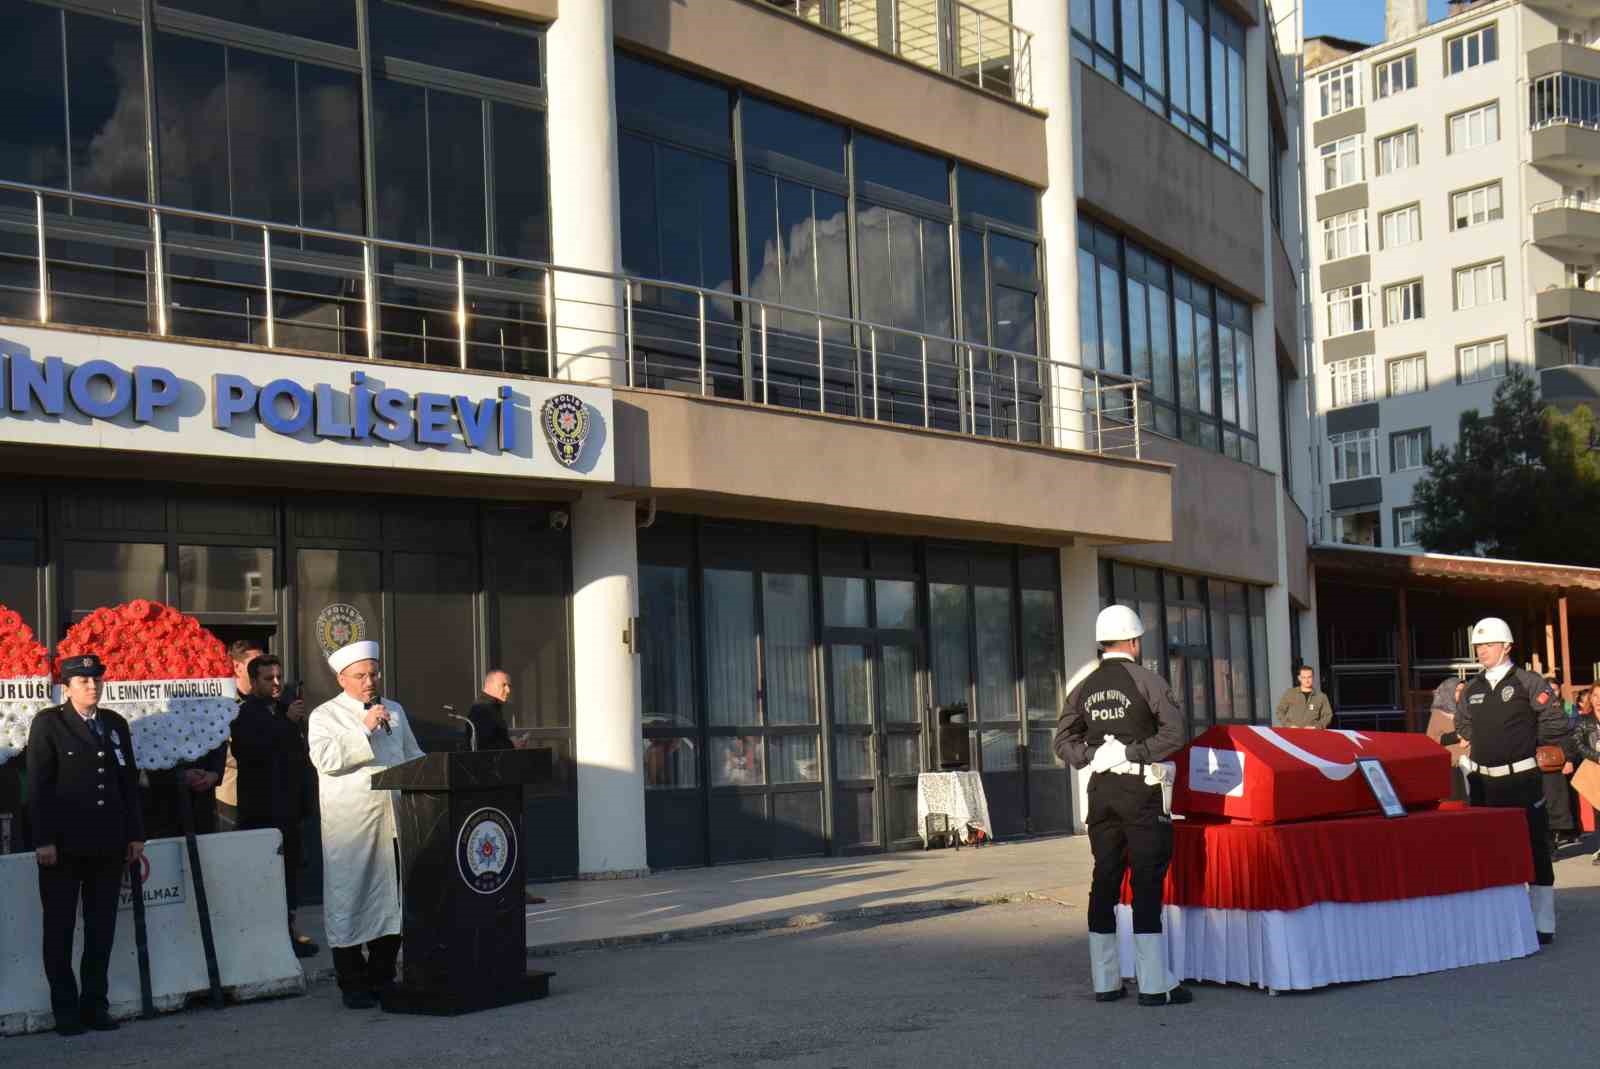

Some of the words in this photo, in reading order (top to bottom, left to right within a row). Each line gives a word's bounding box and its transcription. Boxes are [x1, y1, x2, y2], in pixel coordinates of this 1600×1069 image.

[0, 352, 180, 422] NOP
[212, 370, 515, 449] POLİSEVİ
[118, 682, 160, 700] EMNİYET
[164, 680, 222, 698] MÜDÜRLÜĞÜ
[120, 886, 179, 905] YAILMAZ
